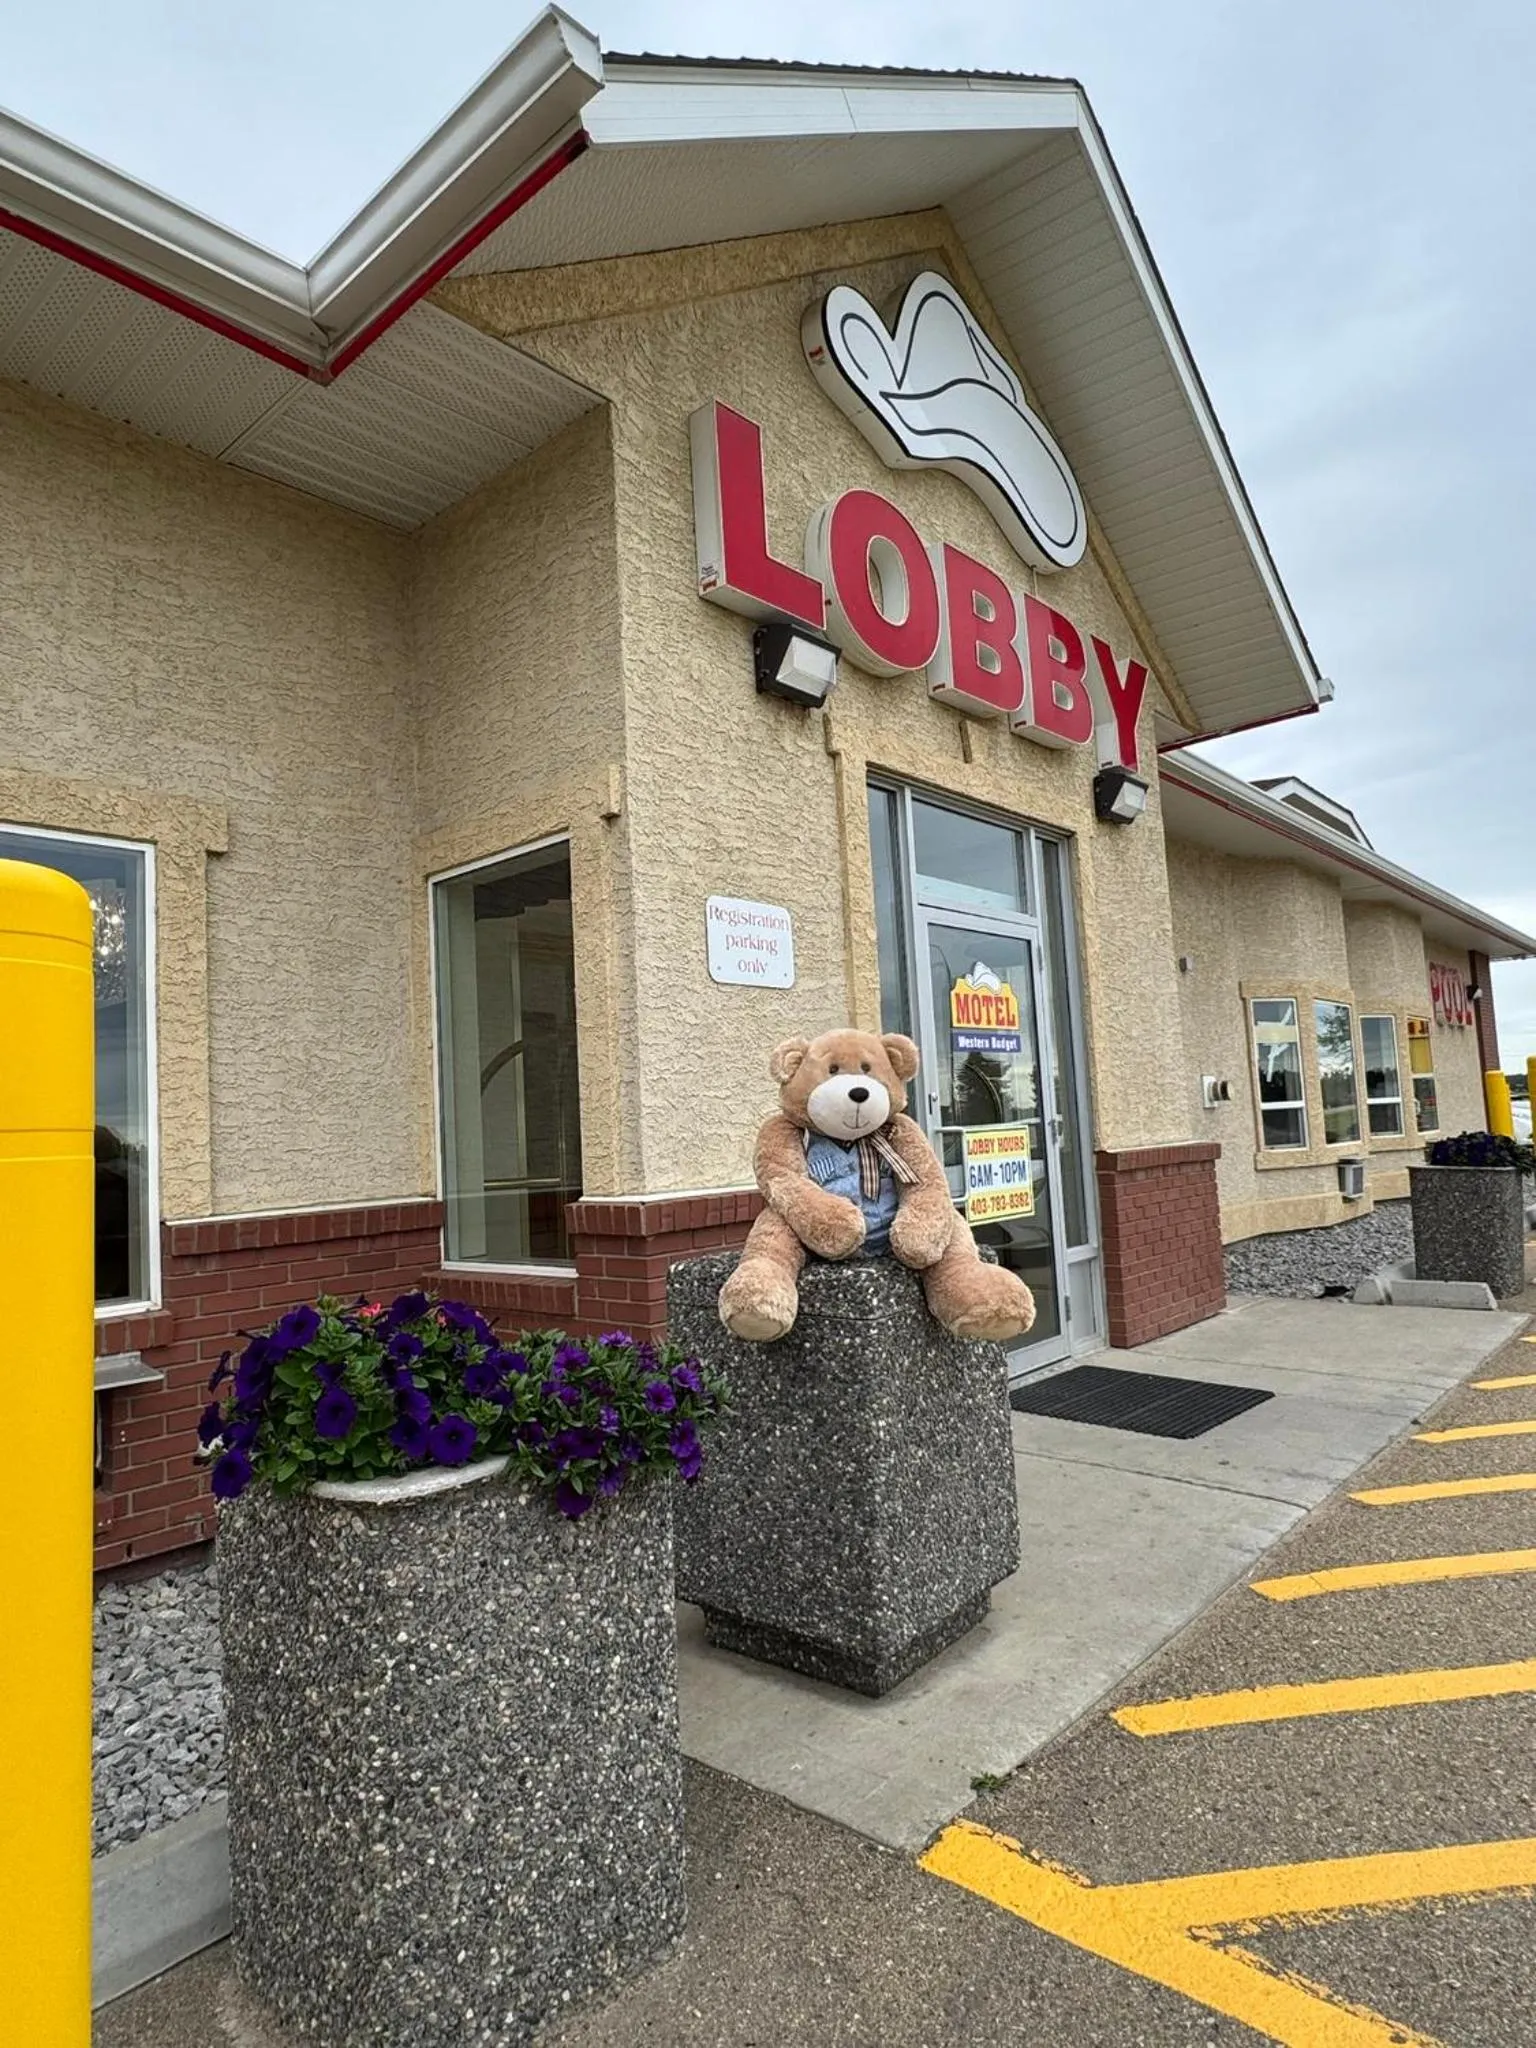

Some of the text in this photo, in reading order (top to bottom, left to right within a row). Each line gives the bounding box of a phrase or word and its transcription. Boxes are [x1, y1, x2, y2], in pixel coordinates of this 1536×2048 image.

[713, 399, 1149, 772] LOBBY
[709, 905, 789, 931] Registration
[1429, 961, 1473, 1026] POOL
[955, 993, 1016, 1026] MOTEL
[957, 1036, 1018, 1052] Western Budget
[967, 1135, 1025, 1155] LOBBY HOURS
